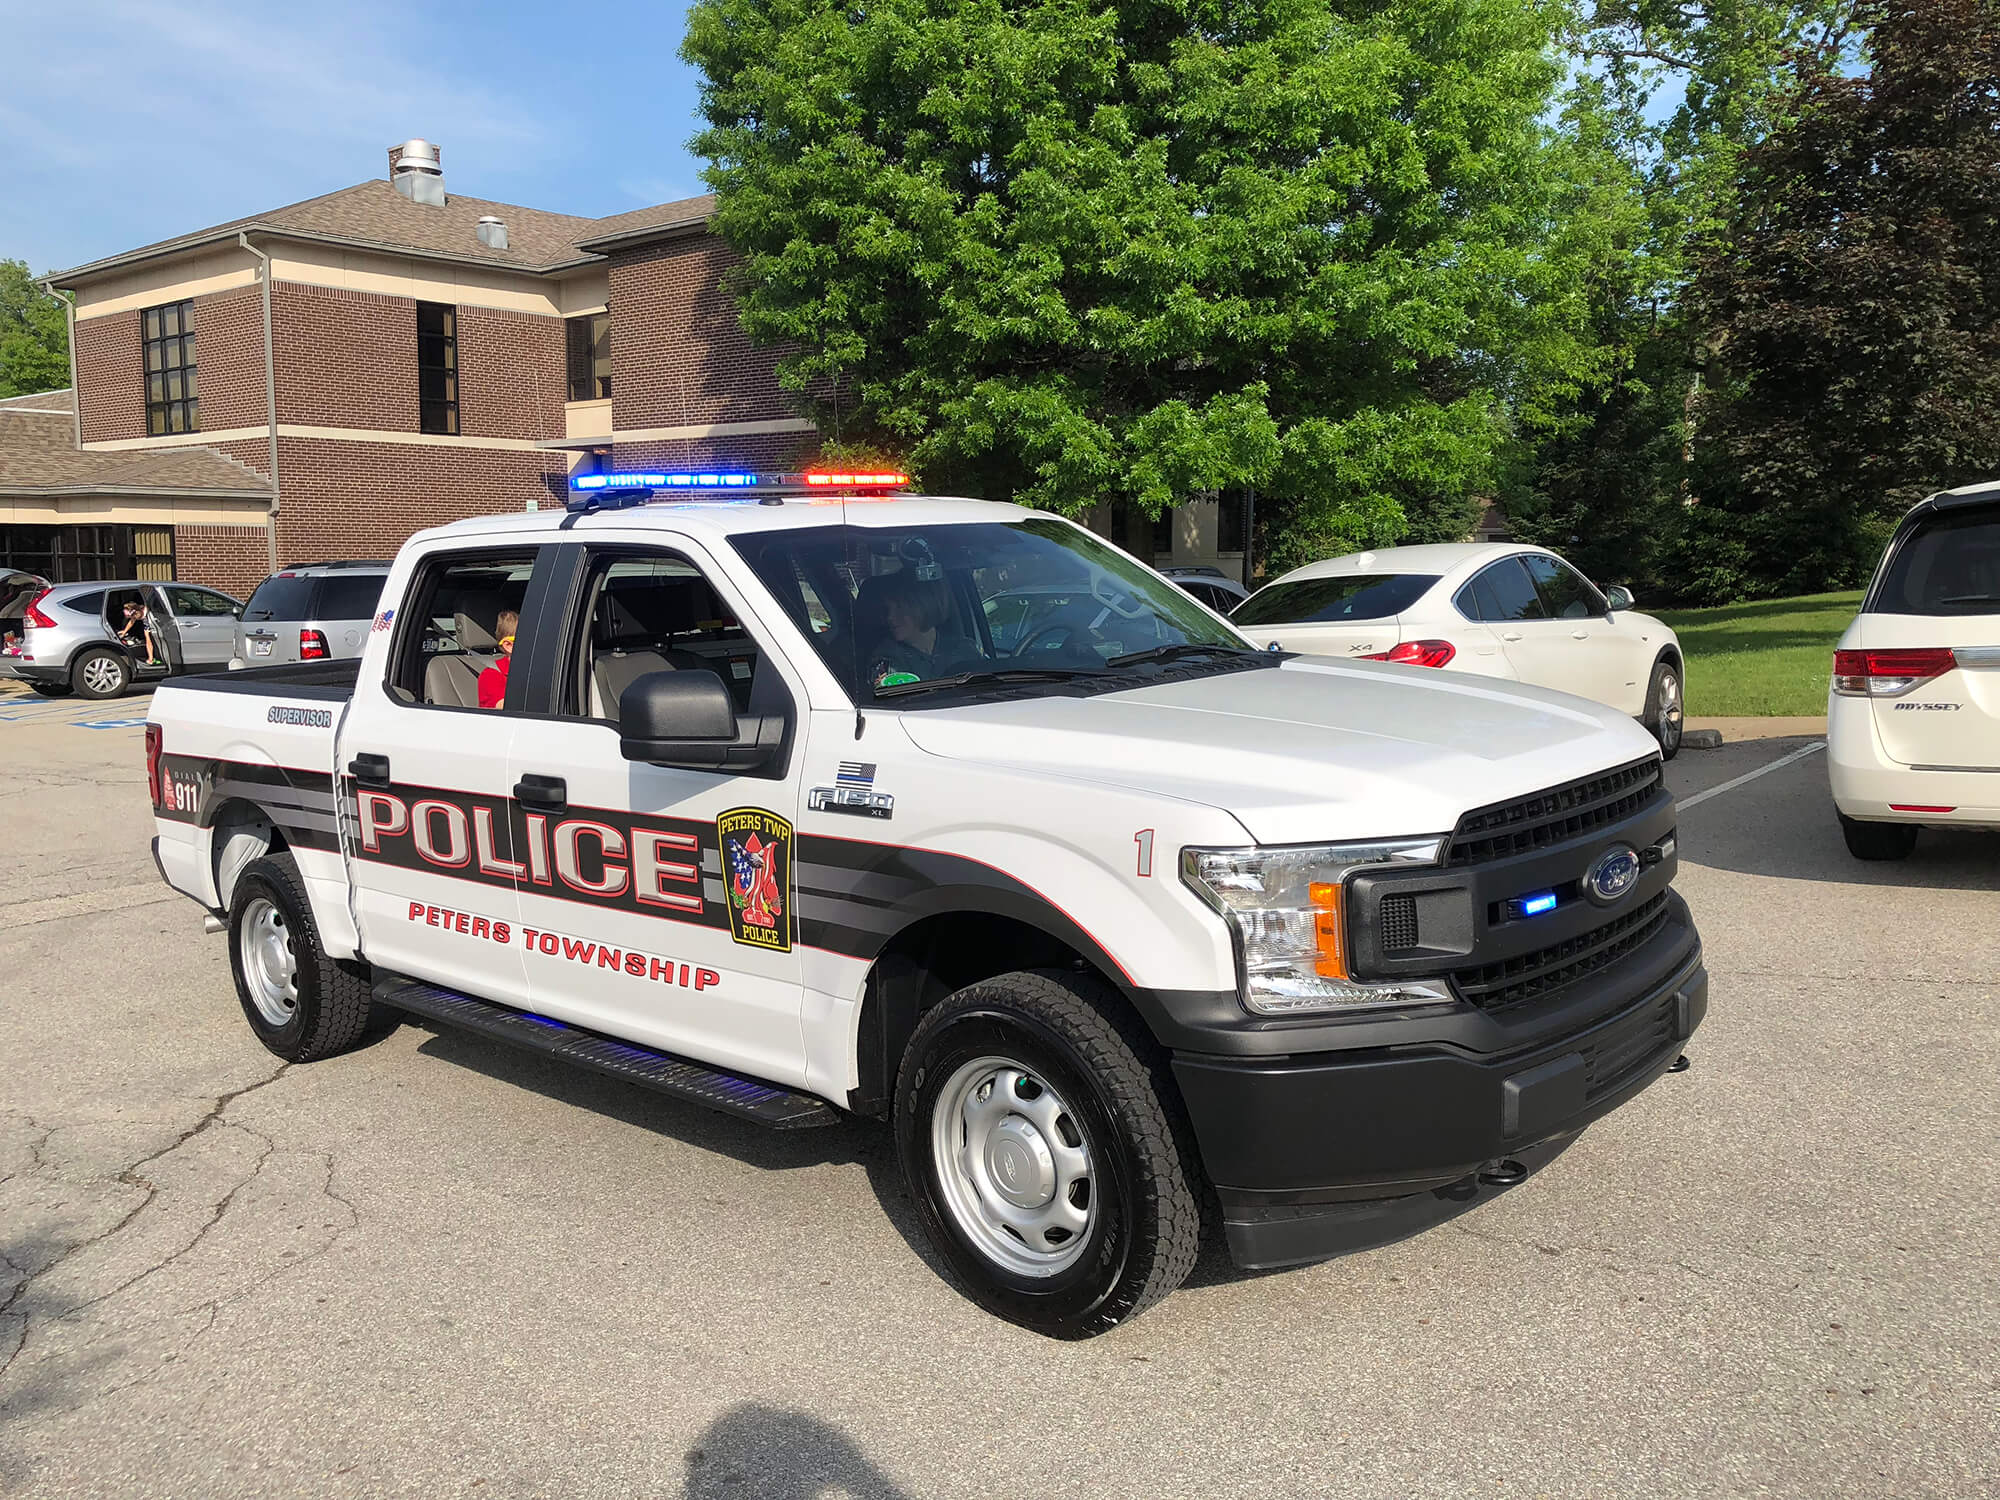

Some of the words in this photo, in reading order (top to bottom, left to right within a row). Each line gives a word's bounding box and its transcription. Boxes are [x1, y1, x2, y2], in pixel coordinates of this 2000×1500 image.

[268, 706, 333, 728] SUPERVISOR
[1894, 703, 1964, 711] ODYSSEY
[174, 771, 196, 781] DIAL
[175, 782, 197, 813] 911
[720, 814, 761, 835] PETERS
[764, 818, 788, 841] TWP
[356, 789, 704, 914] POLICE
[1134, 828, 1155, 878] 1
[408, 901, 511, 944] PETERS
[522, 927, 720, 992] TOWNSHIP
[742, 924, 780, 945] POLICE
